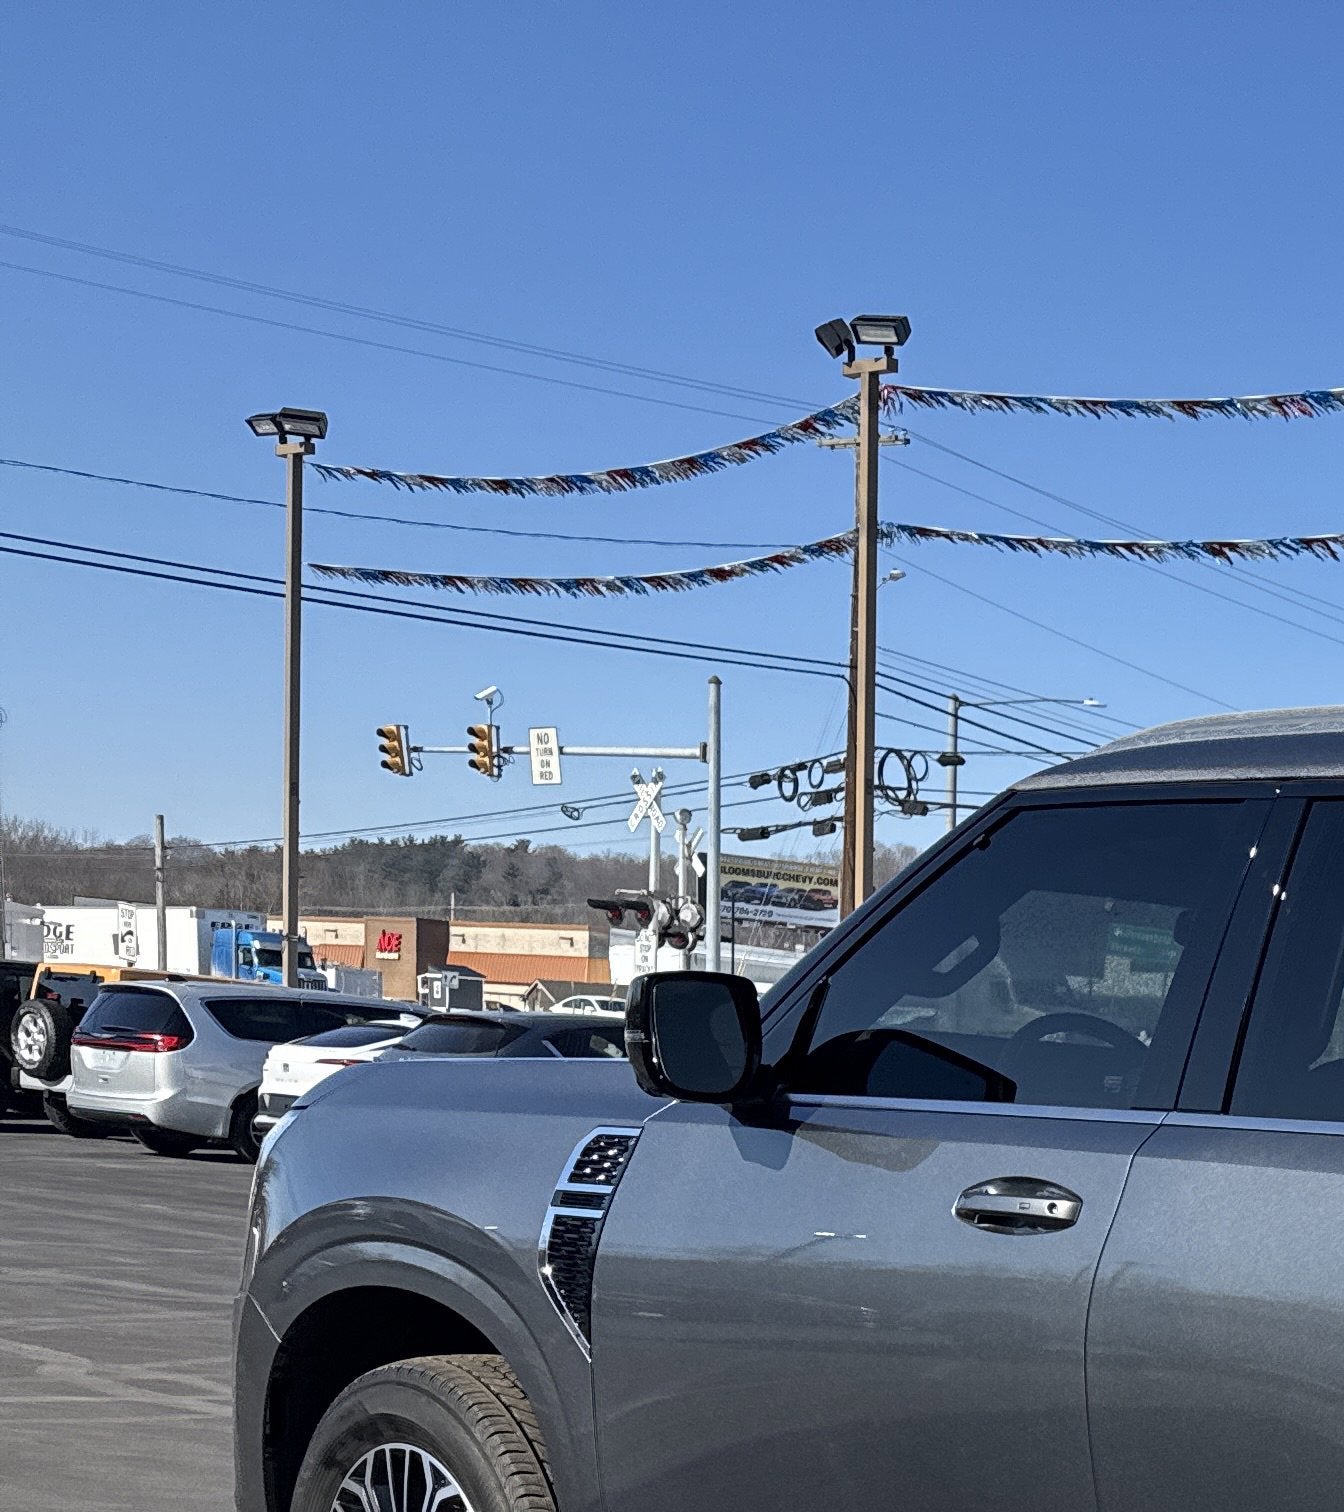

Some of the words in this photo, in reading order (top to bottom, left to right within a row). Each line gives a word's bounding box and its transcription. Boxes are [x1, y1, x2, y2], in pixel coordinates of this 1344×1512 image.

[536, 732, 550, 745] NO
[536, 747, 553, 757] TURN
[540, 759, 551, 769] ON
[539, 770, 554, 781] RED
